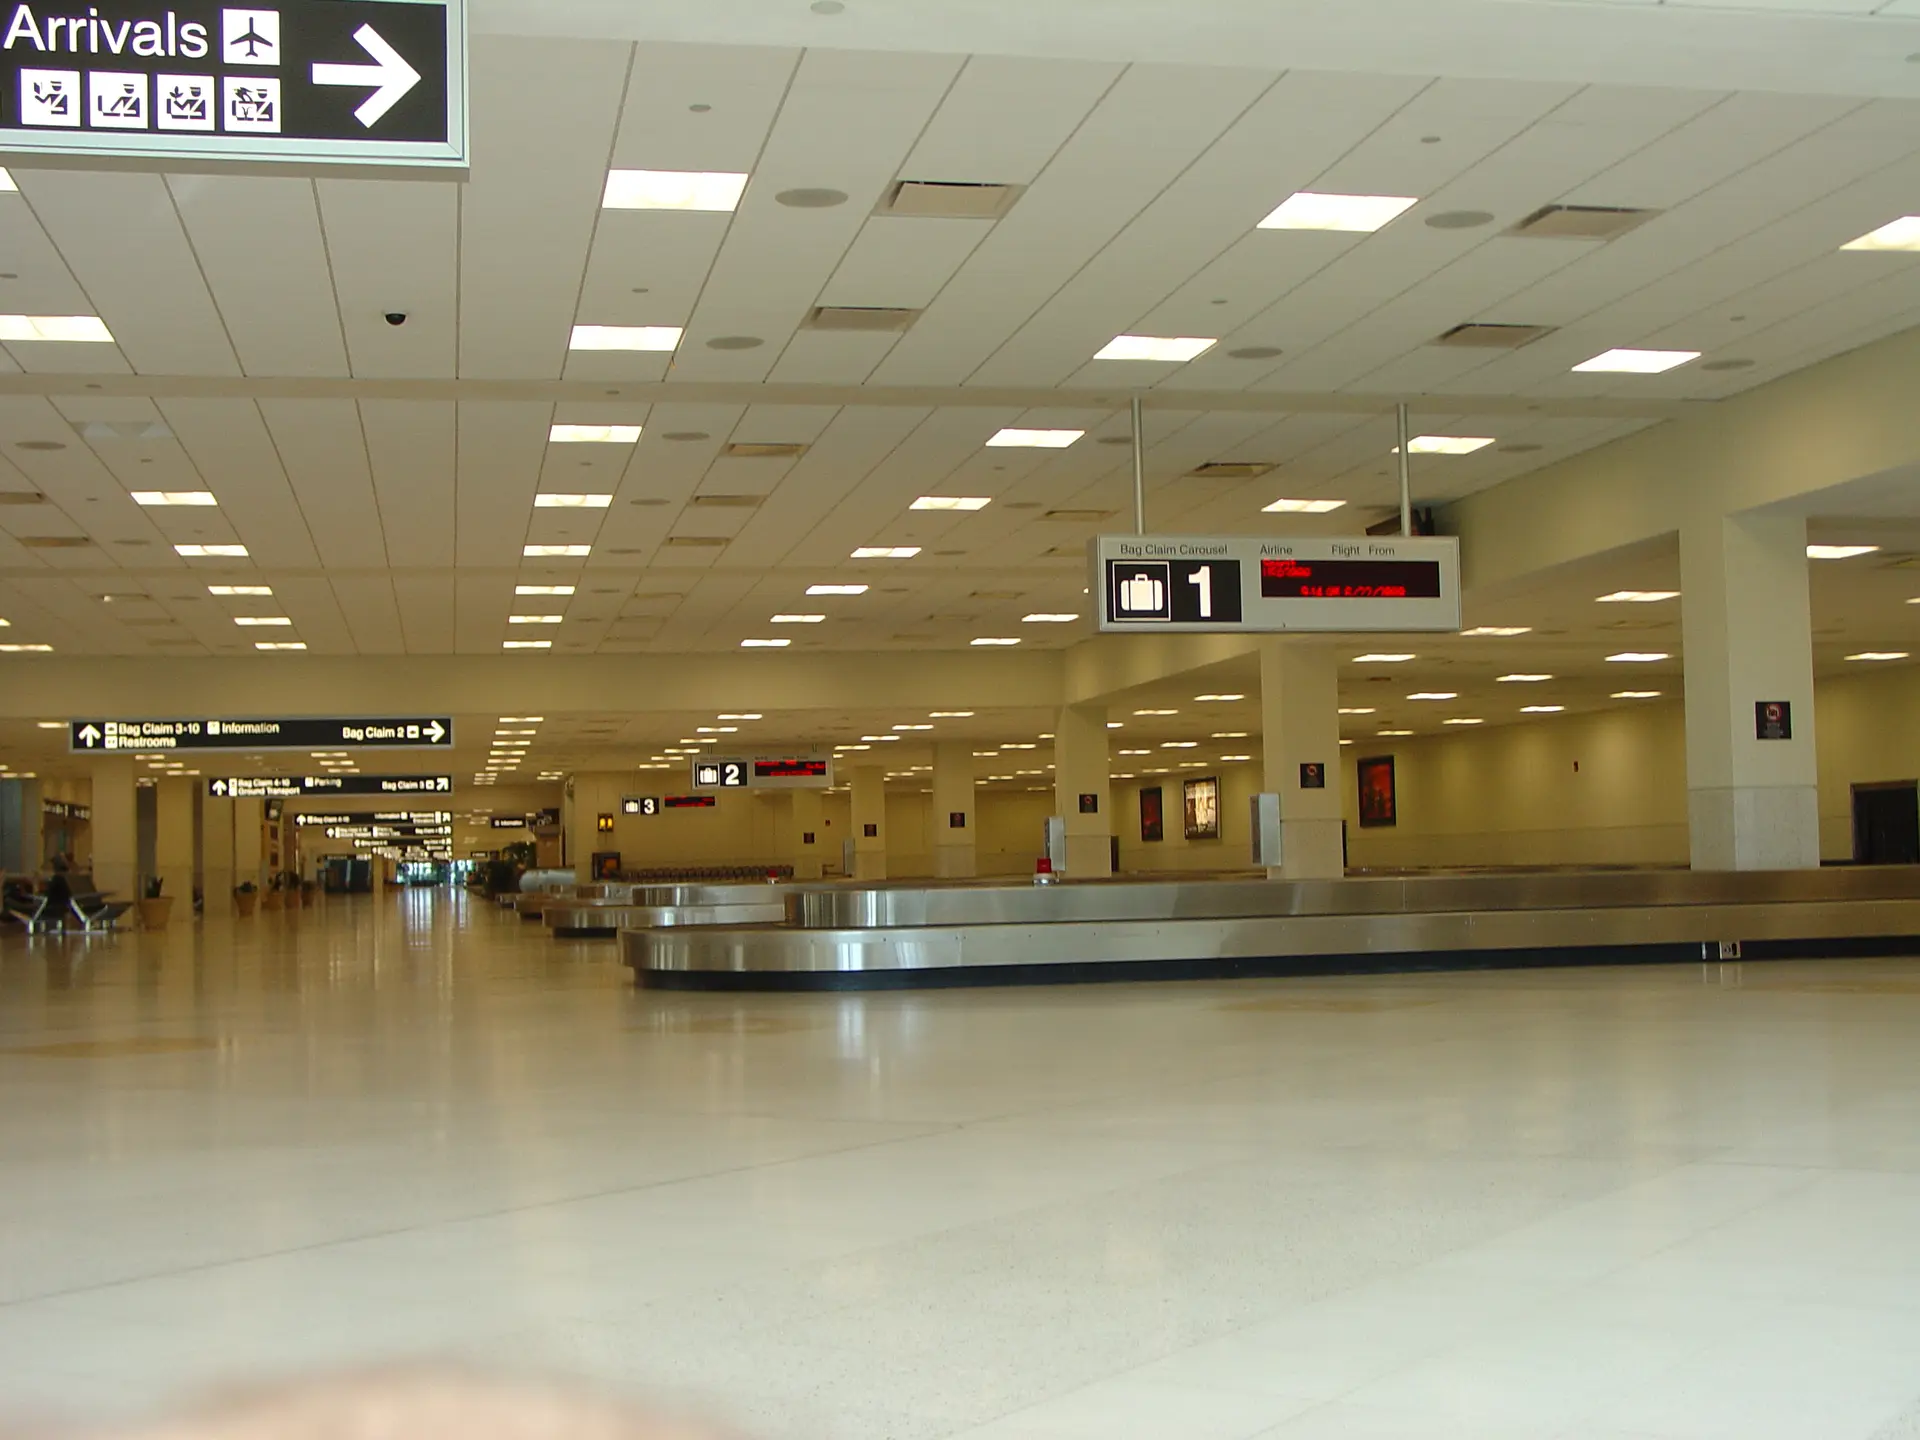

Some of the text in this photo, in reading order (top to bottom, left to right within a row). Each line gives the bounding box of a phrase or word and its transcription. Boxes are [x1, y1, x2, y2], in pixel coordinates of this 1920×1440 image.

[3, 4, 209, 58] Arrivals
[1120, 544, 1228, 557] Bag Claim Carousel
[1260, 544, 1395, 557] Airline Flight From
[1188, 565, 1212, 618] 1
[119, 722, 200, 736] Bag Claim 3-10
[222, 722, 280, 734] Information
[342, 726, 404, 741] Bag Claim 2
[119, 736, 176, 748] Restrooms
[725, 764, 739, 785] 2
[238, 778, 252, 788] Bag
[253, 778, 273, 787] Claim
[314, 777, 342, 787] Parking
[382, 781, 397, 791] Bag
[397, 780, 418, 790] Claim
[238, 787, 265, 796] Ground
[643, 798, 655, 815] 3
